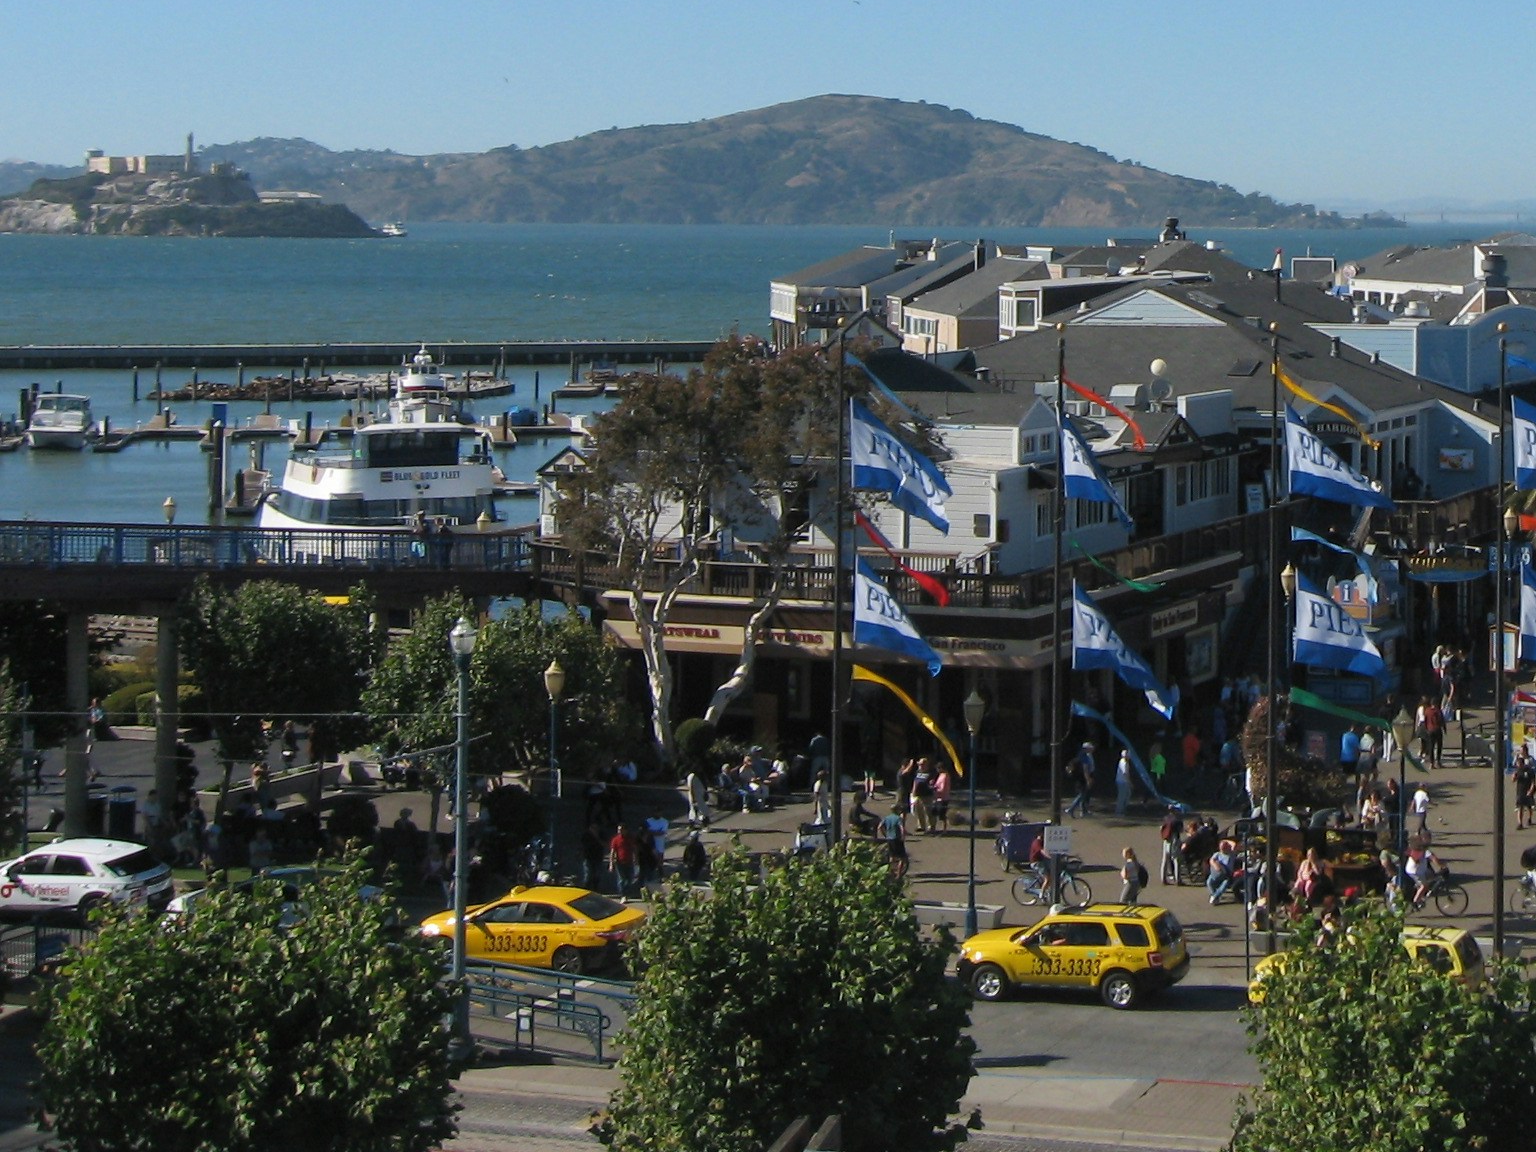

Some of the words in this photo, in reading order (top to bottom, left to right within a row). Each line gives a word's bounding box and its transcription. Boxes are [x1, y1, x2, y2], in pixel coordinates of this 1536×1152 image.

[441, 470, 460, 479] FLEET
[951, 639, 1006, 651] Francisco
[488, 935, 548, 952] 333-3333
[1034, 958, 1101, 976] 333-3333
